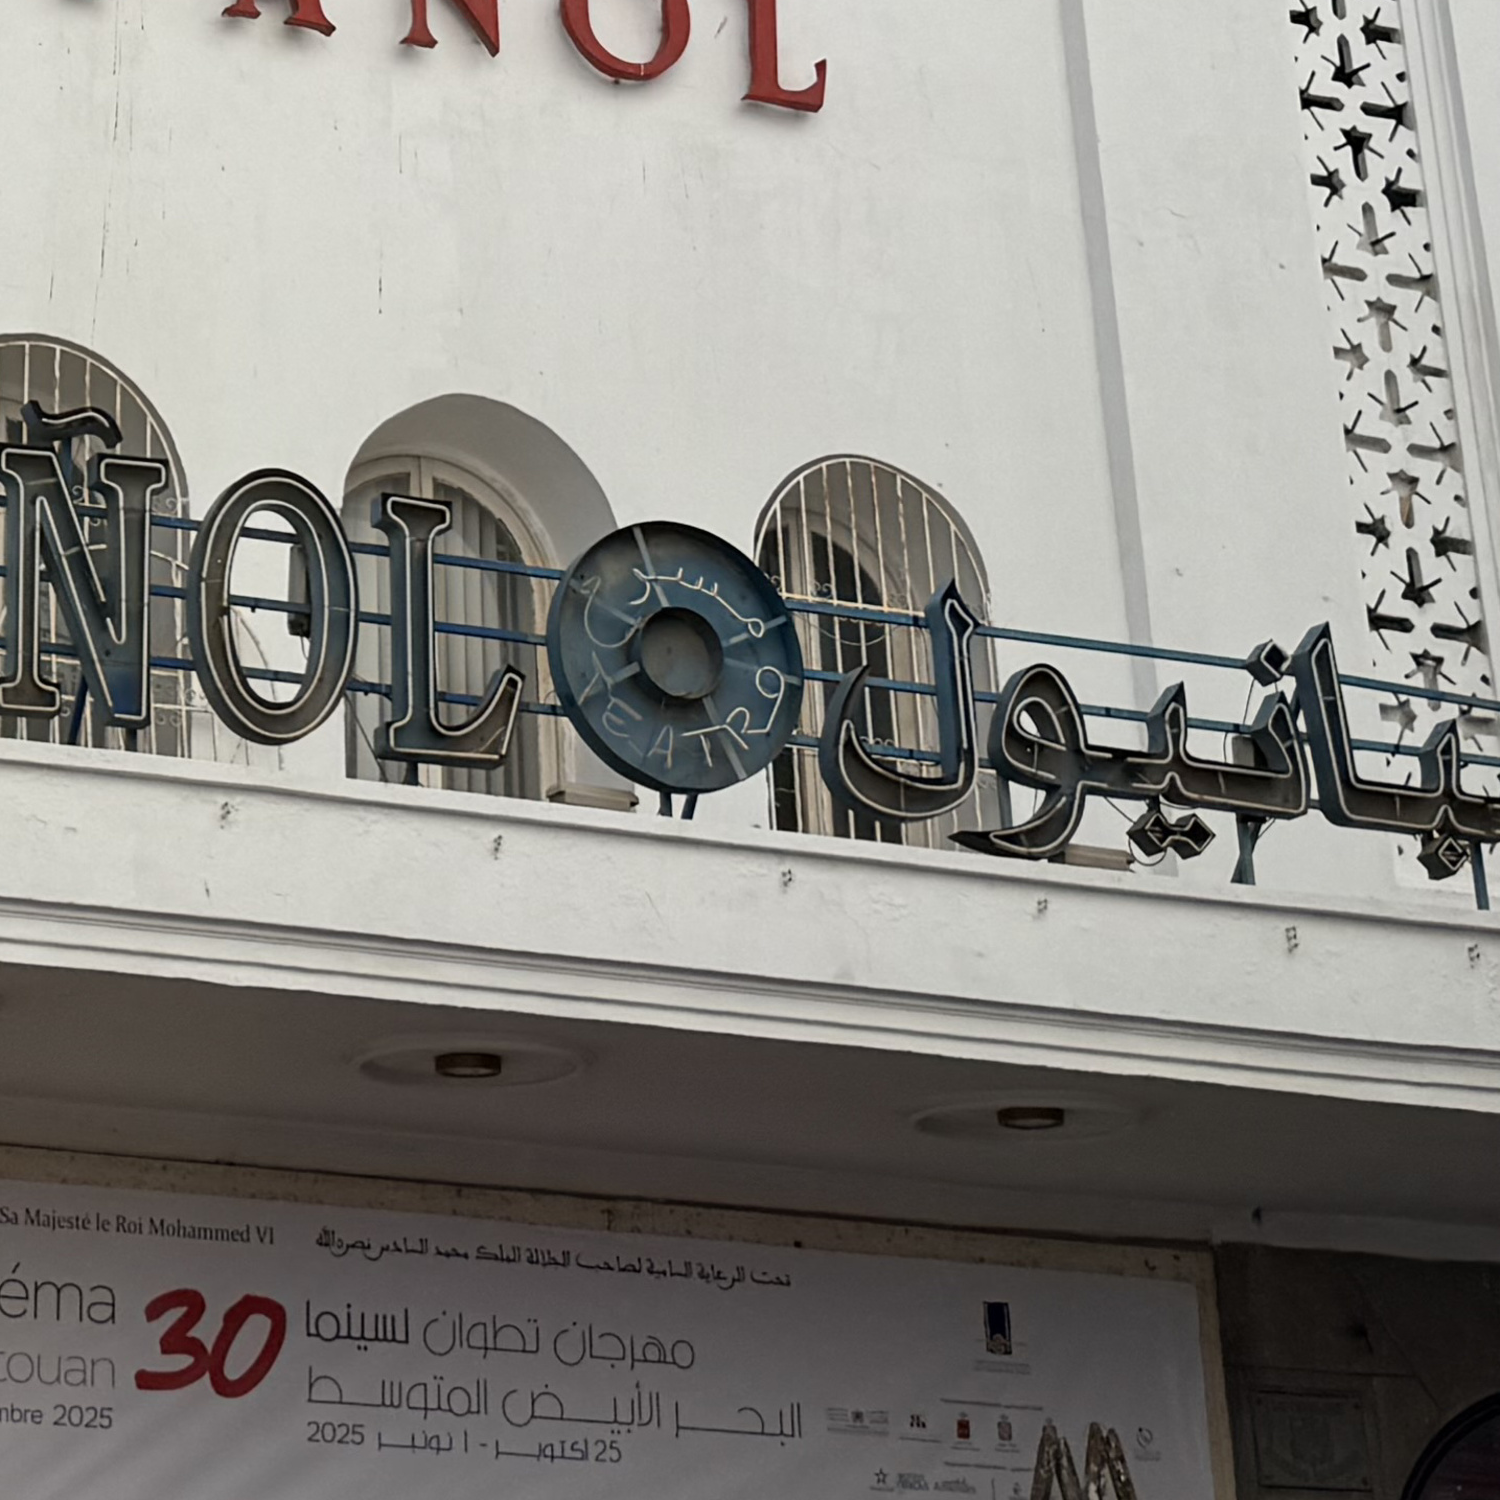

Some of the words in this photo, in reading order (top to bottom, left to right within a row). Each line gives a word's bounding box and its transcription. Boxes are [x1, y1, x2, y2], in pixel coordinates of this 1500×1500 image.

[0, 1205, 20, 1226] Sa
[24, 1208, 92, 1232] Majesté
[96, 1212, 112, 1232] le
[116, 1214, 144, 1235] Roi
[148, 1216, 251, 1244] Mohammed
[255, 1225, 275, 1246] VI
[133, 1287, 288, 1399] 30
[305, 1299, 410, 1352] لسينما
[423, 1309, 540, 1361] تطوان
[553, 1320, 697, 1371] مهرجان
[51, 1403, 115, 1431] 2025
[306, 1365, 489, 1421] المتوسط
[306, 1421, 367, 1447] 2025
[675, 1399, 803, 1447] البحر
[594, 1438, 623, 1464] 25
